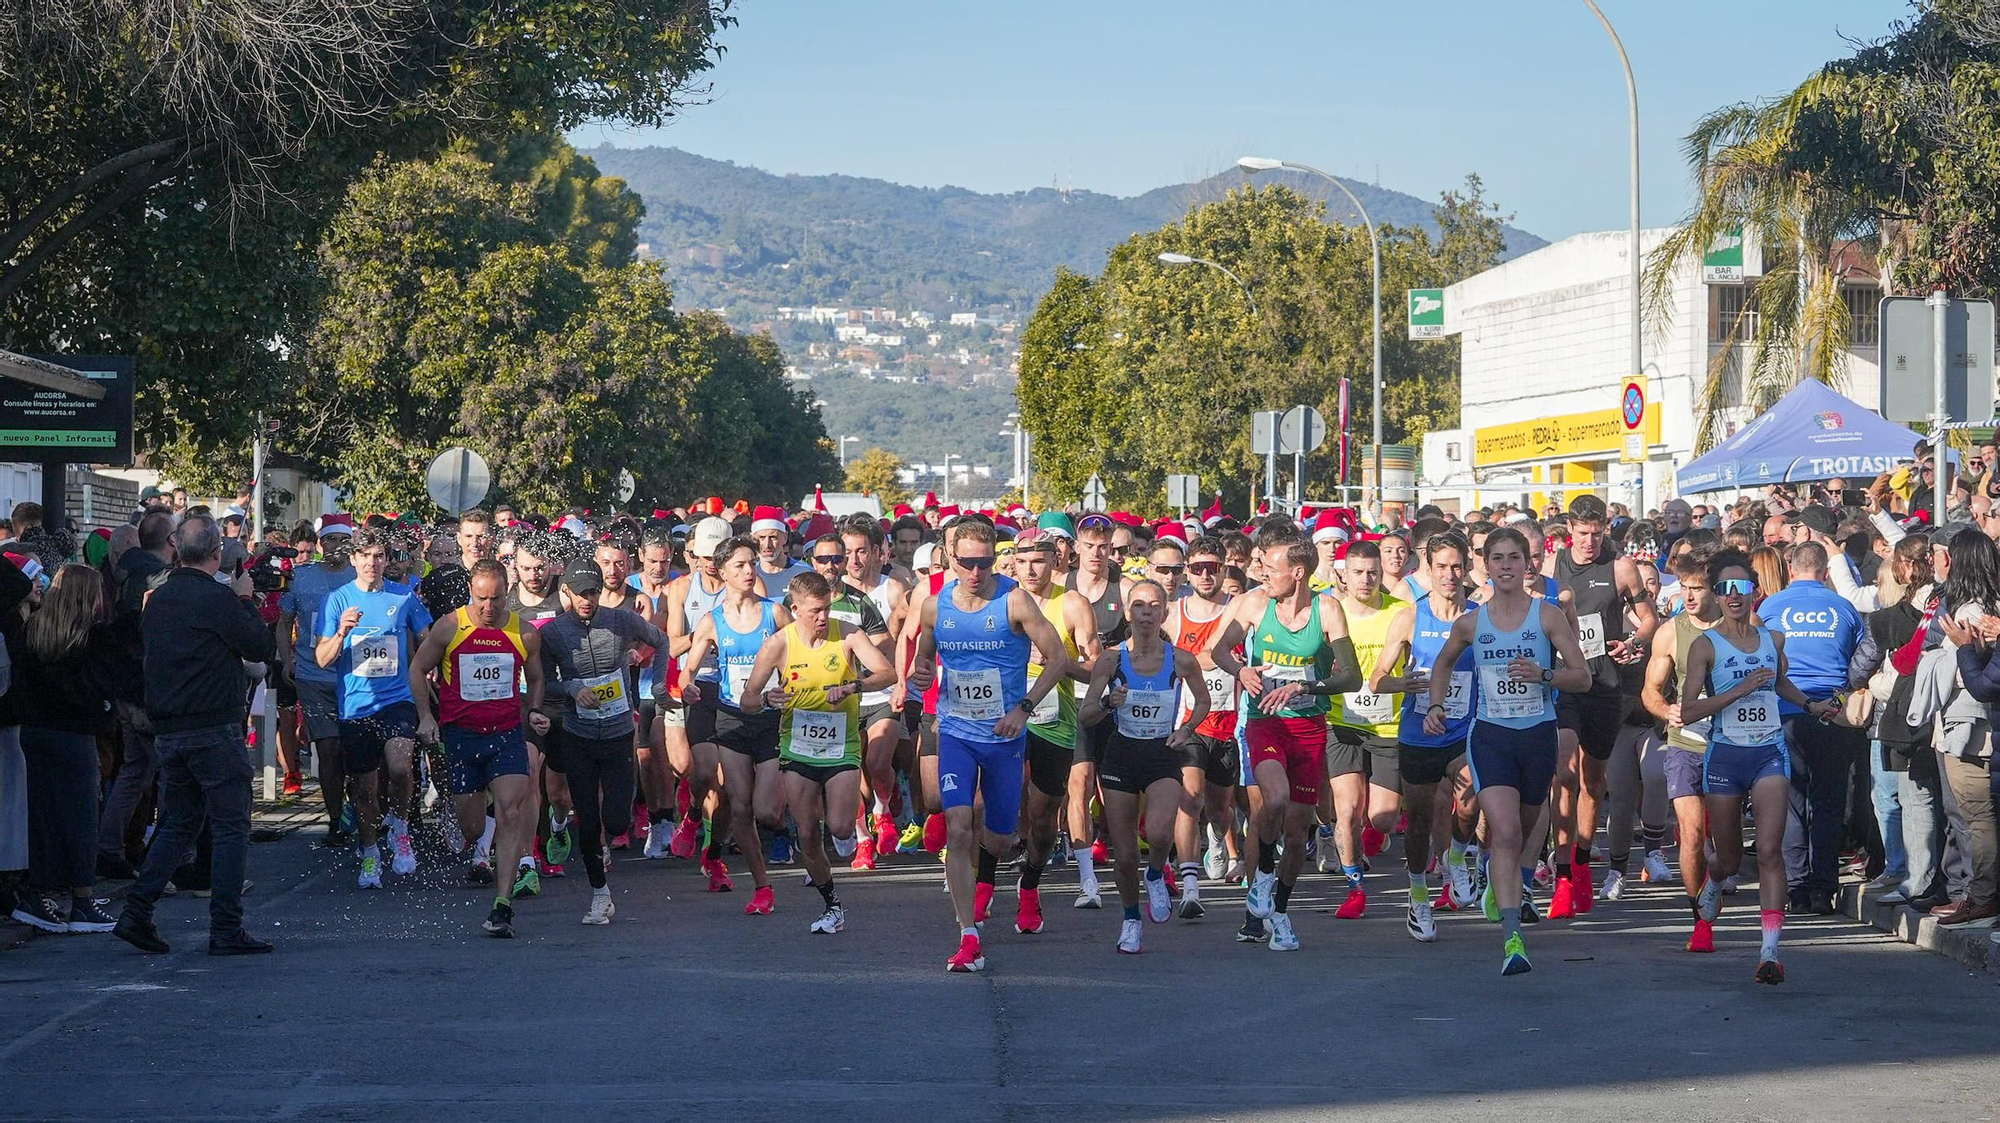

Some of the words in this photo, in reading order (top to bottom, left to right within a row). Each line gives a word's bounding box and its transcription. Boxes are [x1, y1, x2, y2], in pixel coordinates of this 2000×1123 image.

[58, 400, 86, 408] horarios
[1477, 429, 1526, 459] supermercados
[1792, 611, 1828, 624] GCC
[1785, 630, 1808, 638] SPORT
[1809, 630, 1836, 639] EVENTS
[473, 639, 502, 647] MADOC
[938, 640, 1006, 652] TROTASIERRA
[363, 647, 388, 660] 916
[473, 667, 501, 680] 408
[954, 685, 993, 700] 1126
[1497, 680, 1528, 695] 885
[1354, 694, 1380, 707] 487
[1131, 705, 1161, 719] 667
[1737, 707, 1767, 722] 858
[801, 723, 837, 740] 1524
